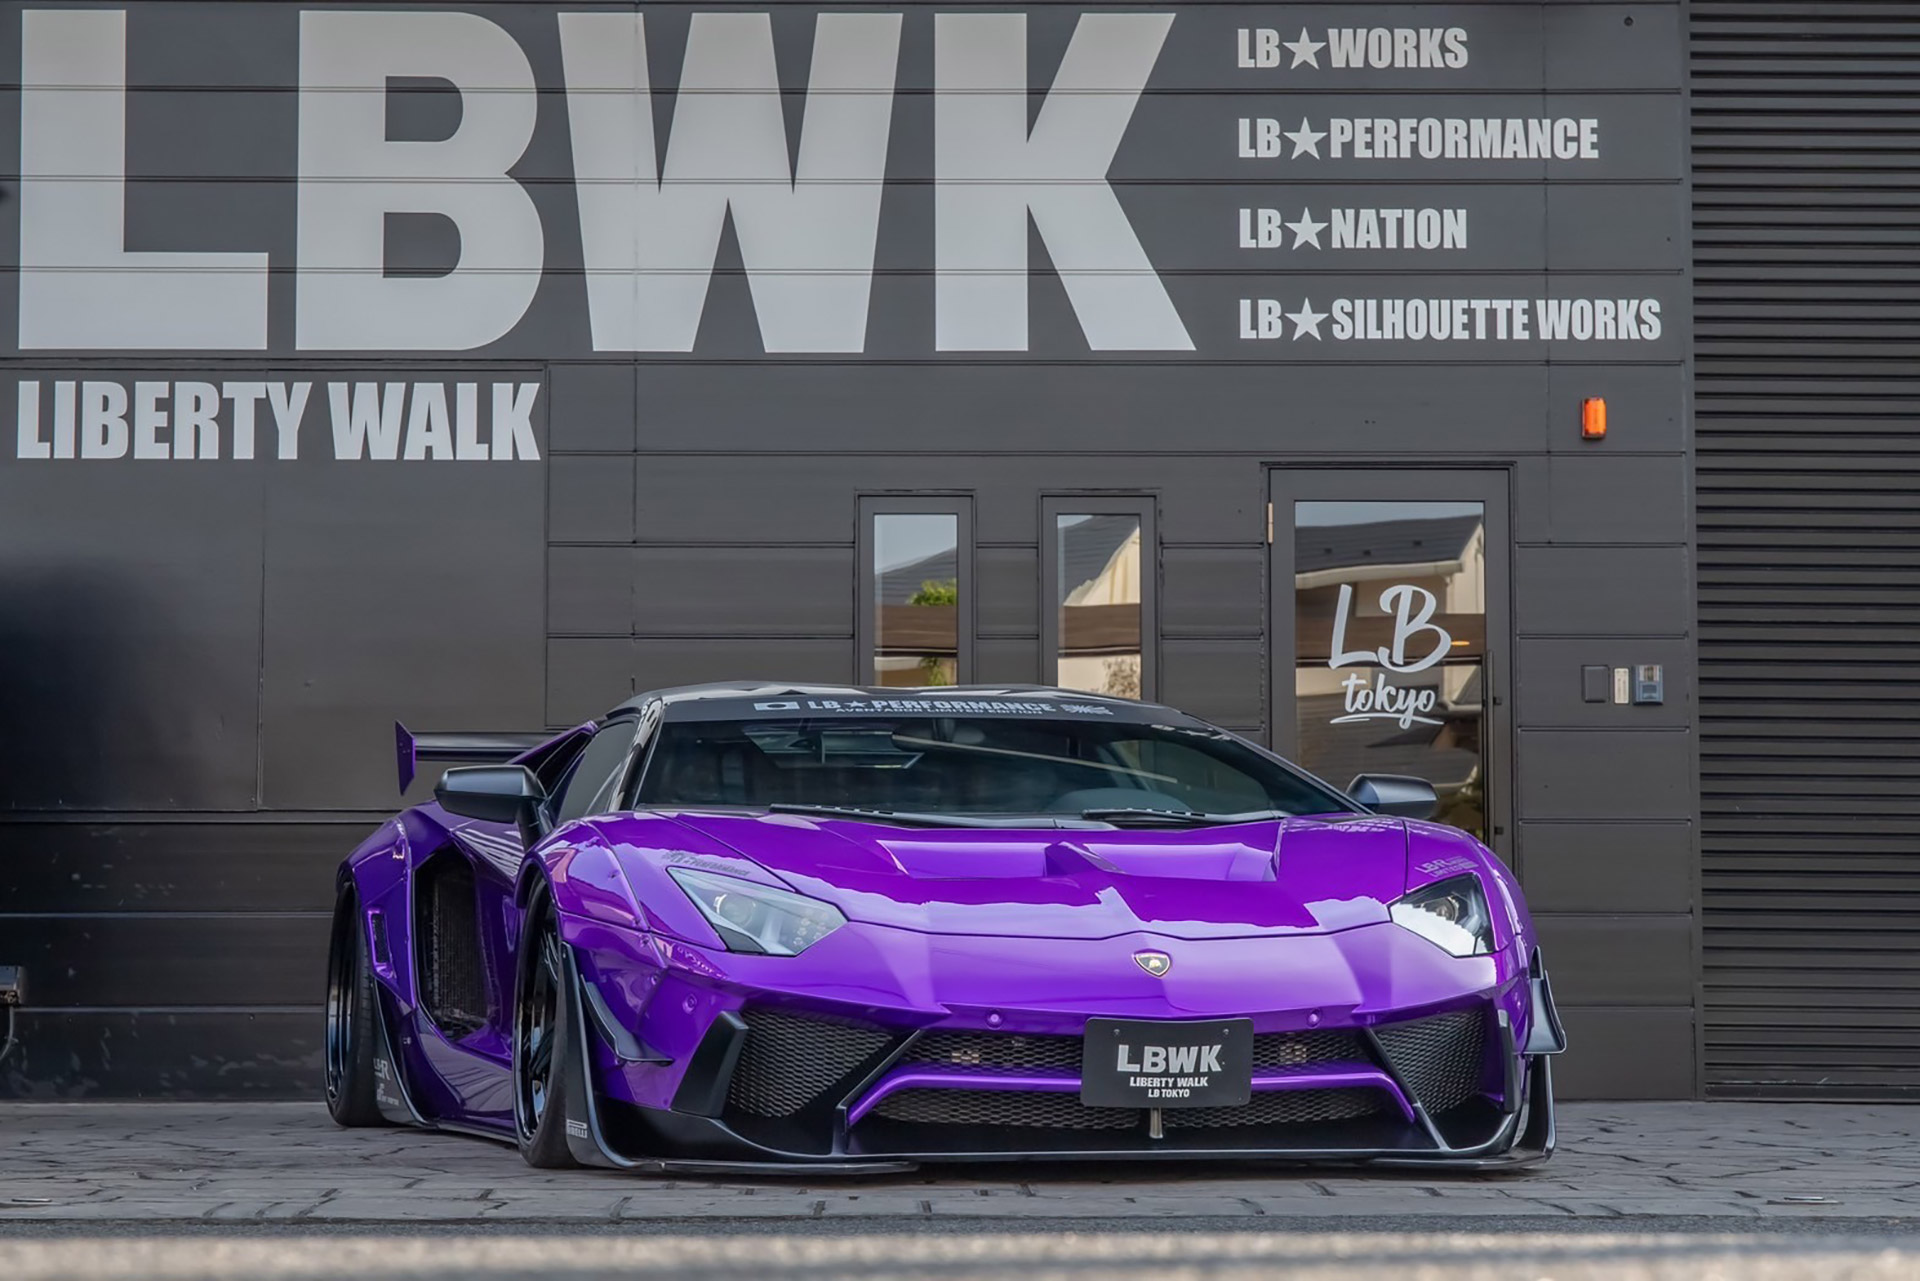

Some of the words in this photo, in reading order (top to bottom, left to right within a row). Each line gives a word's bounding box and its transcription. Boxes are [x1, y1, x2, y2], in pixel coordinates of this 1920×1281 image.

[1328, 27, 1468, 69] WORKS
[1330, 118, 1599, 159] PERFORMANCE
[18, 9, 1197, 353] LBWK
[1331, 208, 1467, 249] NATION
[1332, 298, 1529, 340] SILHOUETTE
[1536, 299, 1662, 340] WORKS
[16, 380, 312, 460] LIBERTY
[328, 381, 541, 461] WALK
[1328, 584, 1452, 673] LB
[1341, 672, 1436, 729] tokyo
[1117, 1044, 1222, 1073] LBWK
[1129, 1076, 1175, 1088] LIBERTY
[1177, 1076, 1209, 1088] WALK
[1147, 1088, 1160, 1098] LB
[1161, 1088, 1190, 1098] TOKYO
